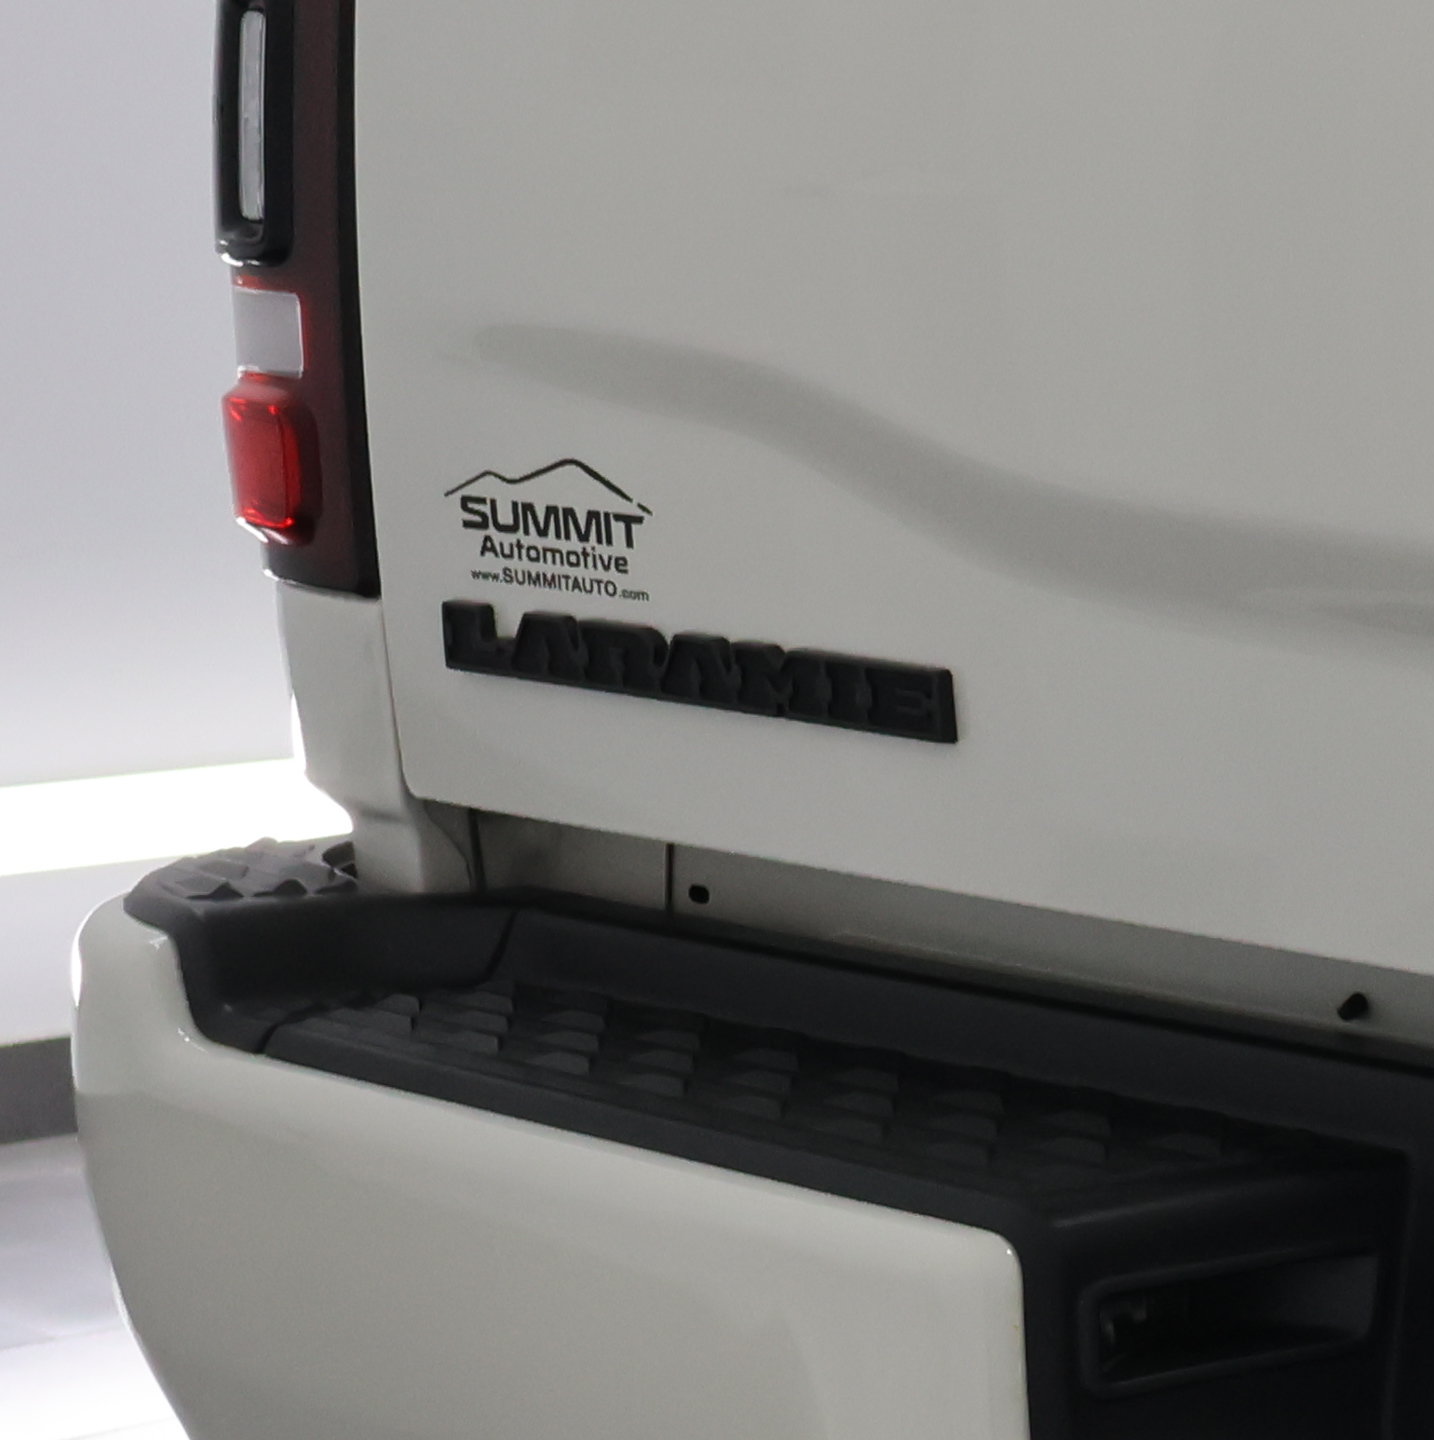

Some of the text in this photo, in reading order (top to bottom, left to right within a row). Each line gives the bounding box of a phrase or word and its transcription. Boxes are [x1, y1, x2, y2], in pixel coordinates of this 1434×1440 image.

[460, 494, 645, 549] SUMMIT
[480, 534, 629, 574] Automotive
[471, 567, 650, 602] www.SUMMITAUTO.com
[442, 599, 958, 744] LARAMIE
